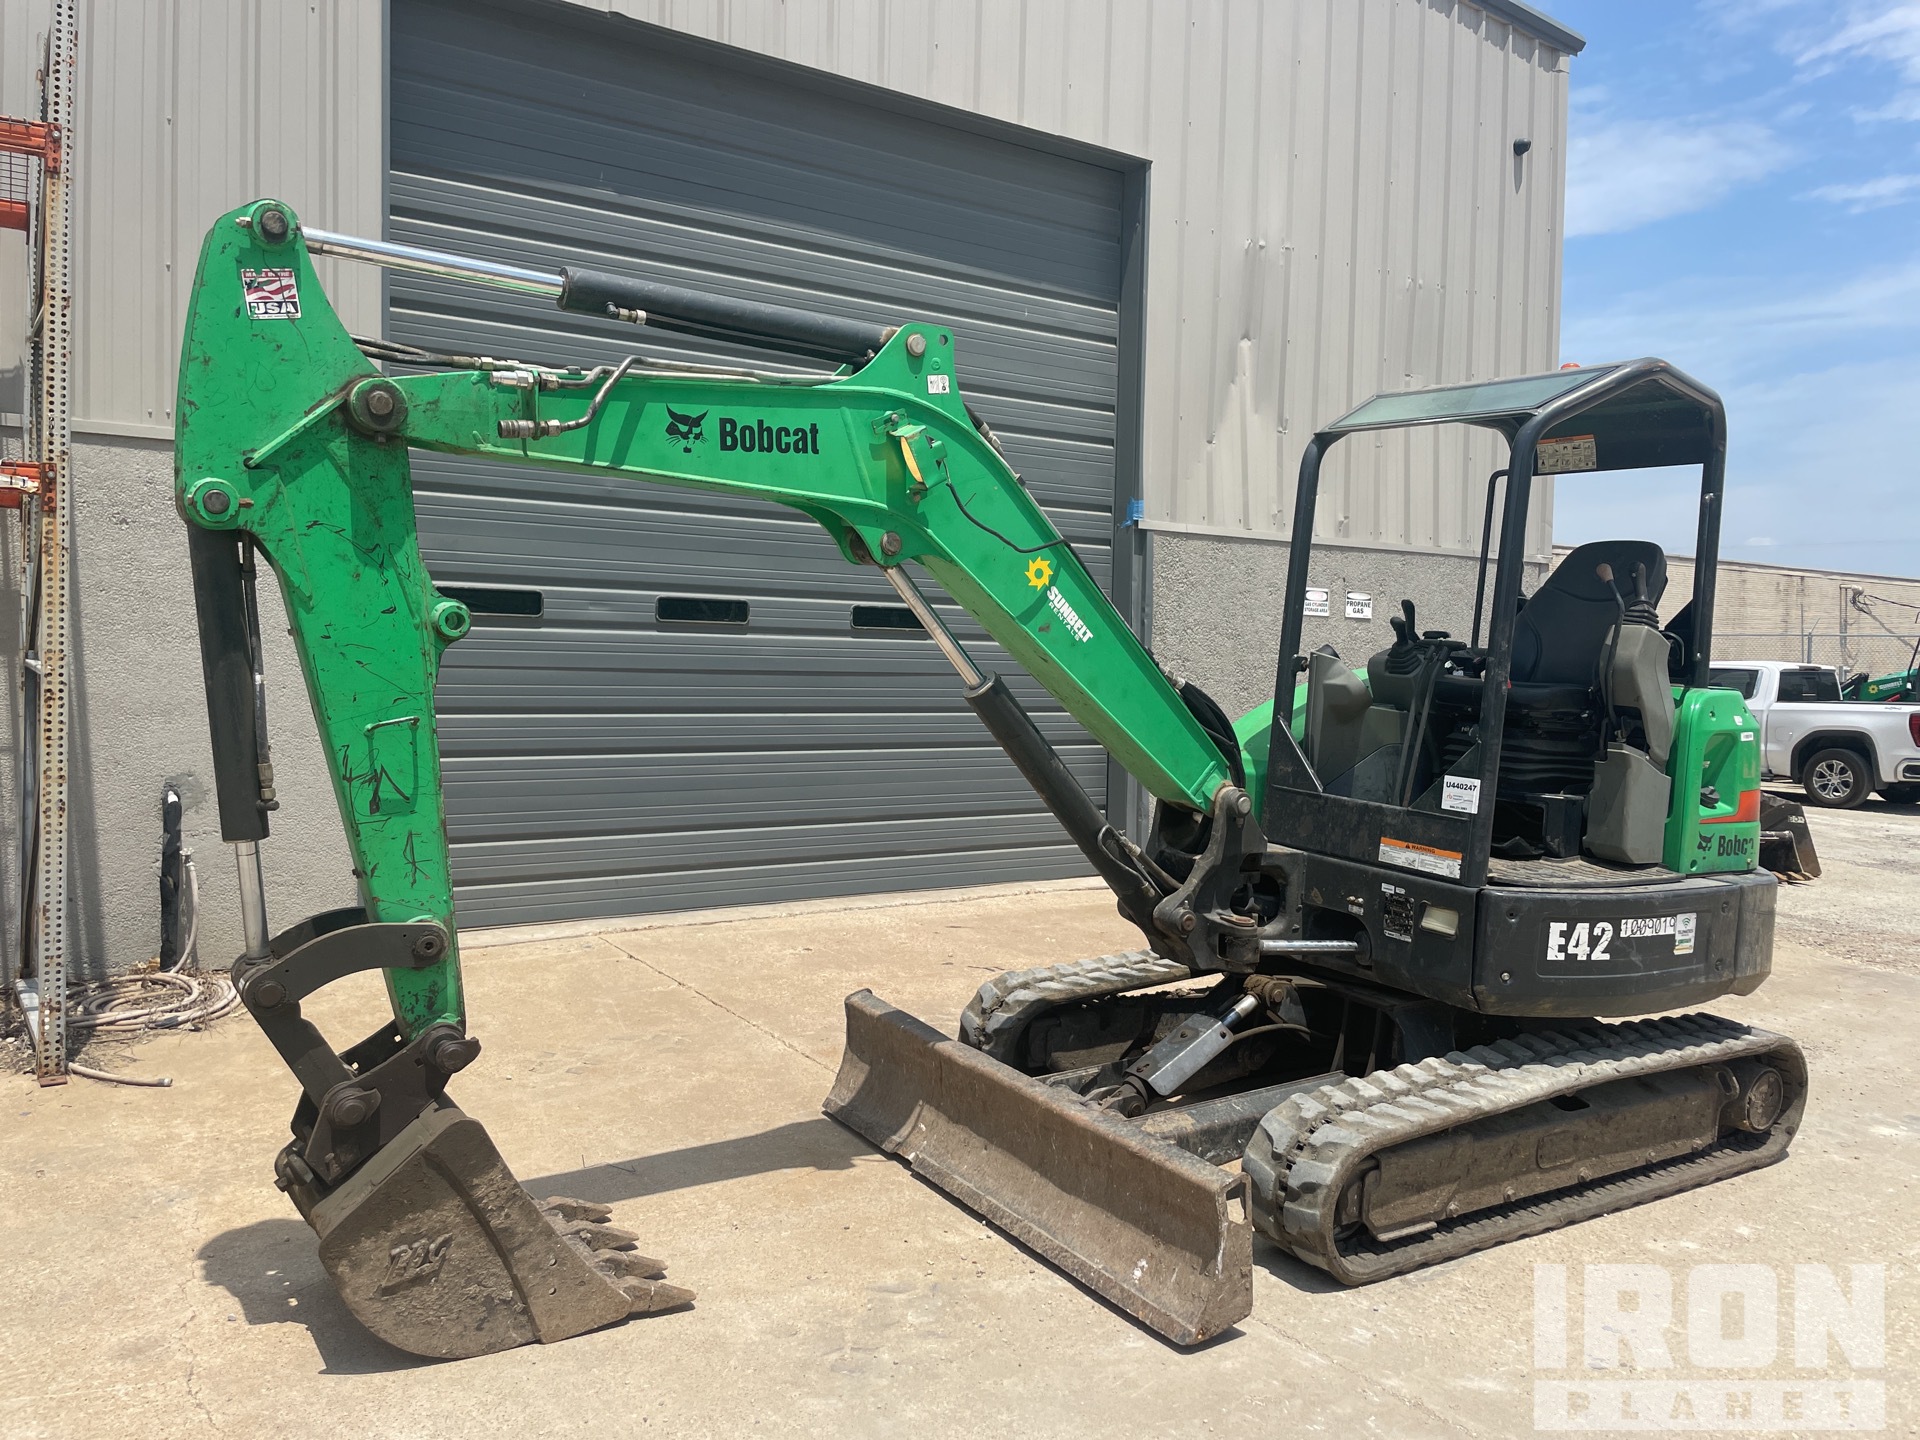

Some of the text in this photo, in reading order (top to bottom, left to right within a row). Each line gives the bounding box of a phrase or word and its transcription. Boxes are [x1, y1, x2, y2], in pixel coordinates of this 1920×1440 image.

[251, 302, 297, 314] USA
[719, 417, 819, 454] Bobcat
[1047, 586, 1094, 643] SUNBELT
[1346, 600, 1371, 608] PROPANE
[1048, 601, 1080, 641] RENTALS
[1446, 781, 1477, 791] U440247
[1411, 844, 1436, 854] WARNING
[1718, 835, 1755, 856] Bobc
[1546, 921, 1614, 961] E42
